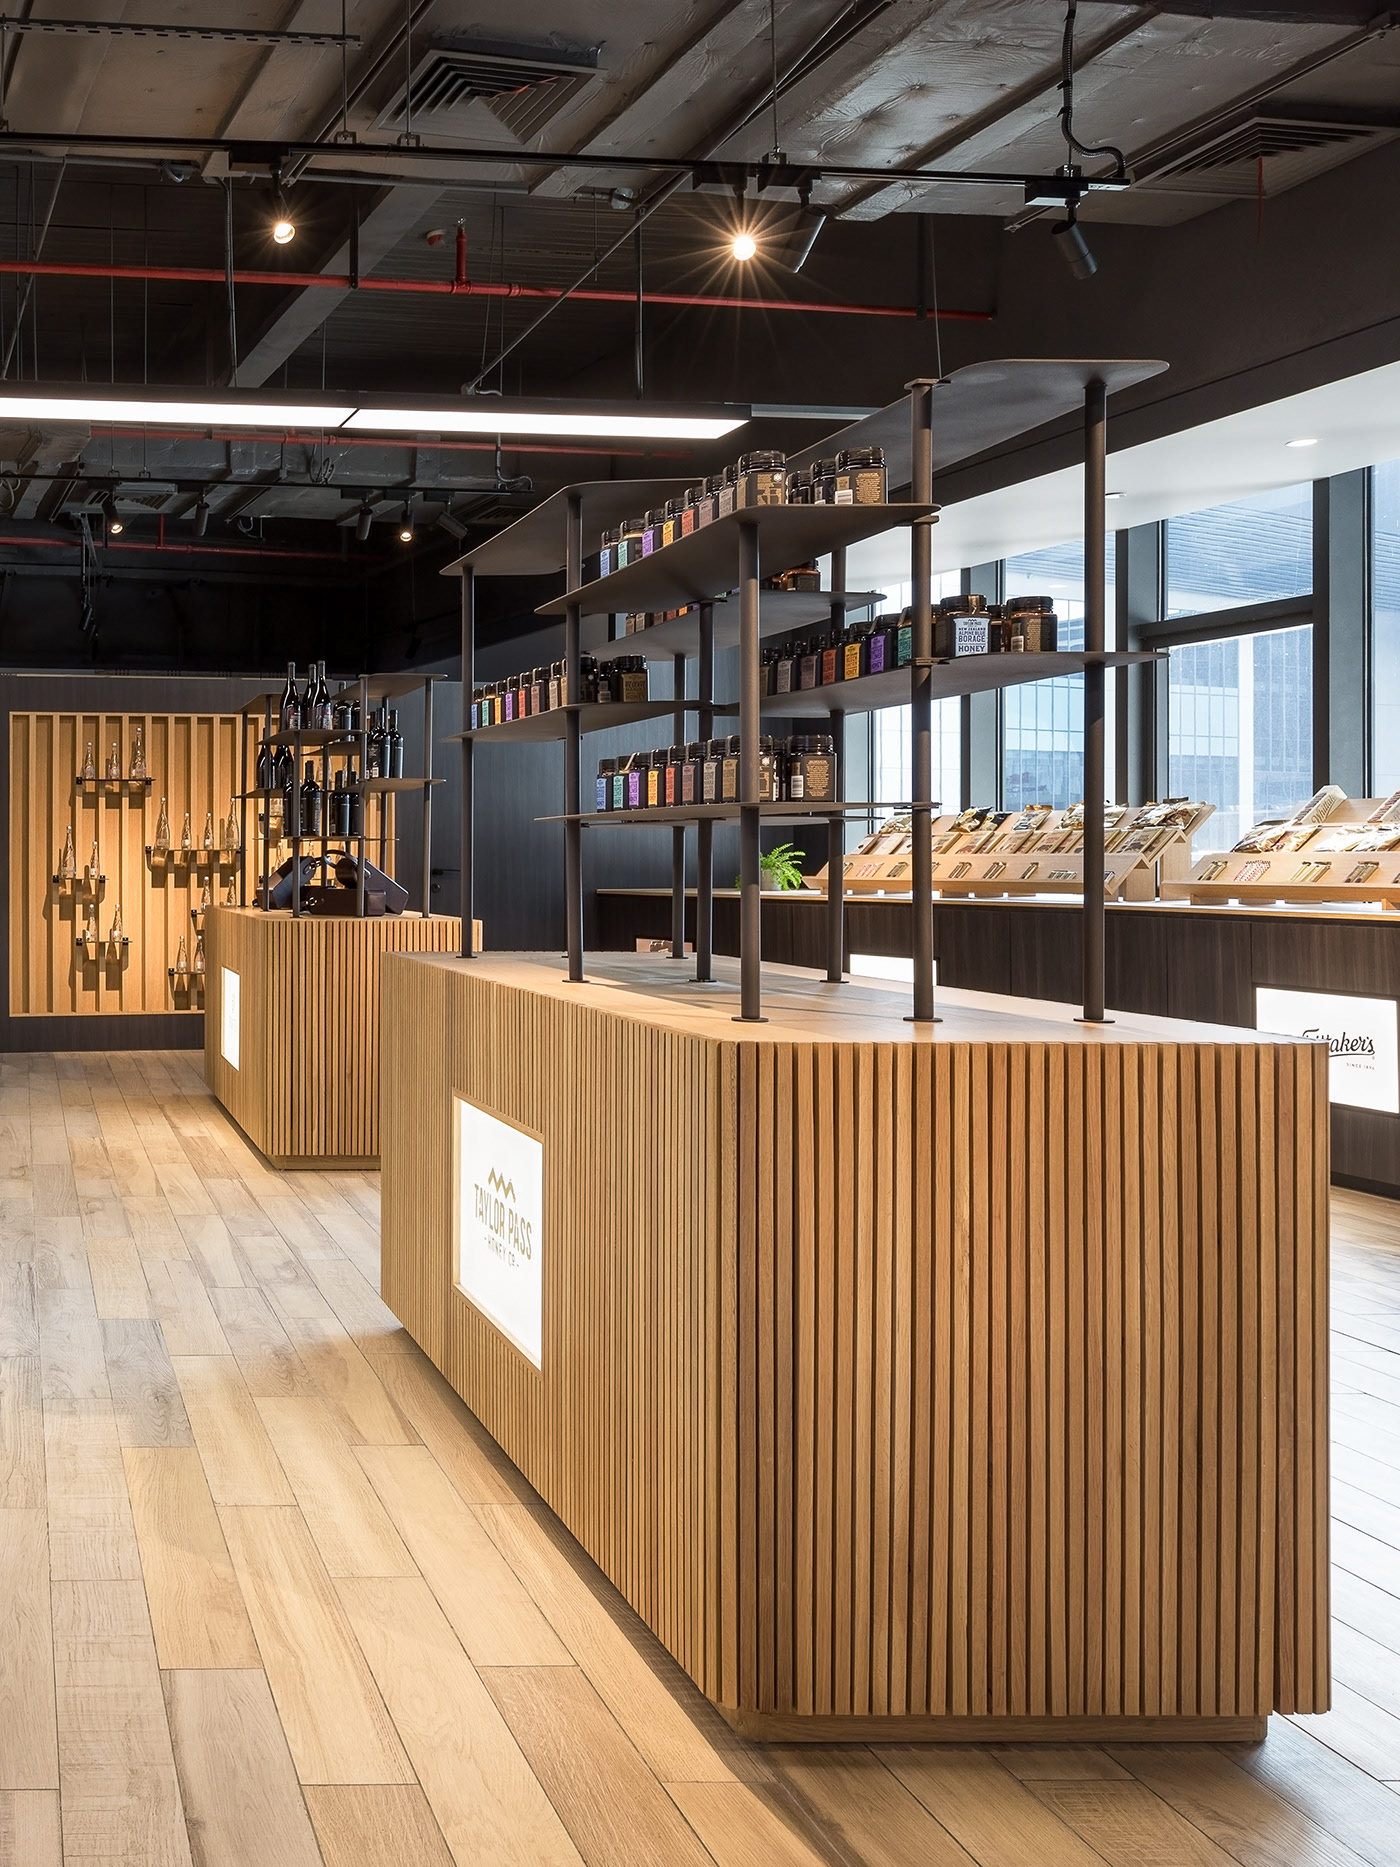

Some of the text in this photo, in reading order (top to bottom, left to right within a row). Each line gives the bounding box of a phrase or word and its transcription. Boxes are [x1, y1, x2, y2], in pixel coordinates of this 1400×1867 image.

[958, 635, 986, 643] BORAGE
[474, 1183, 532, 1261] TAYLOR PASS
